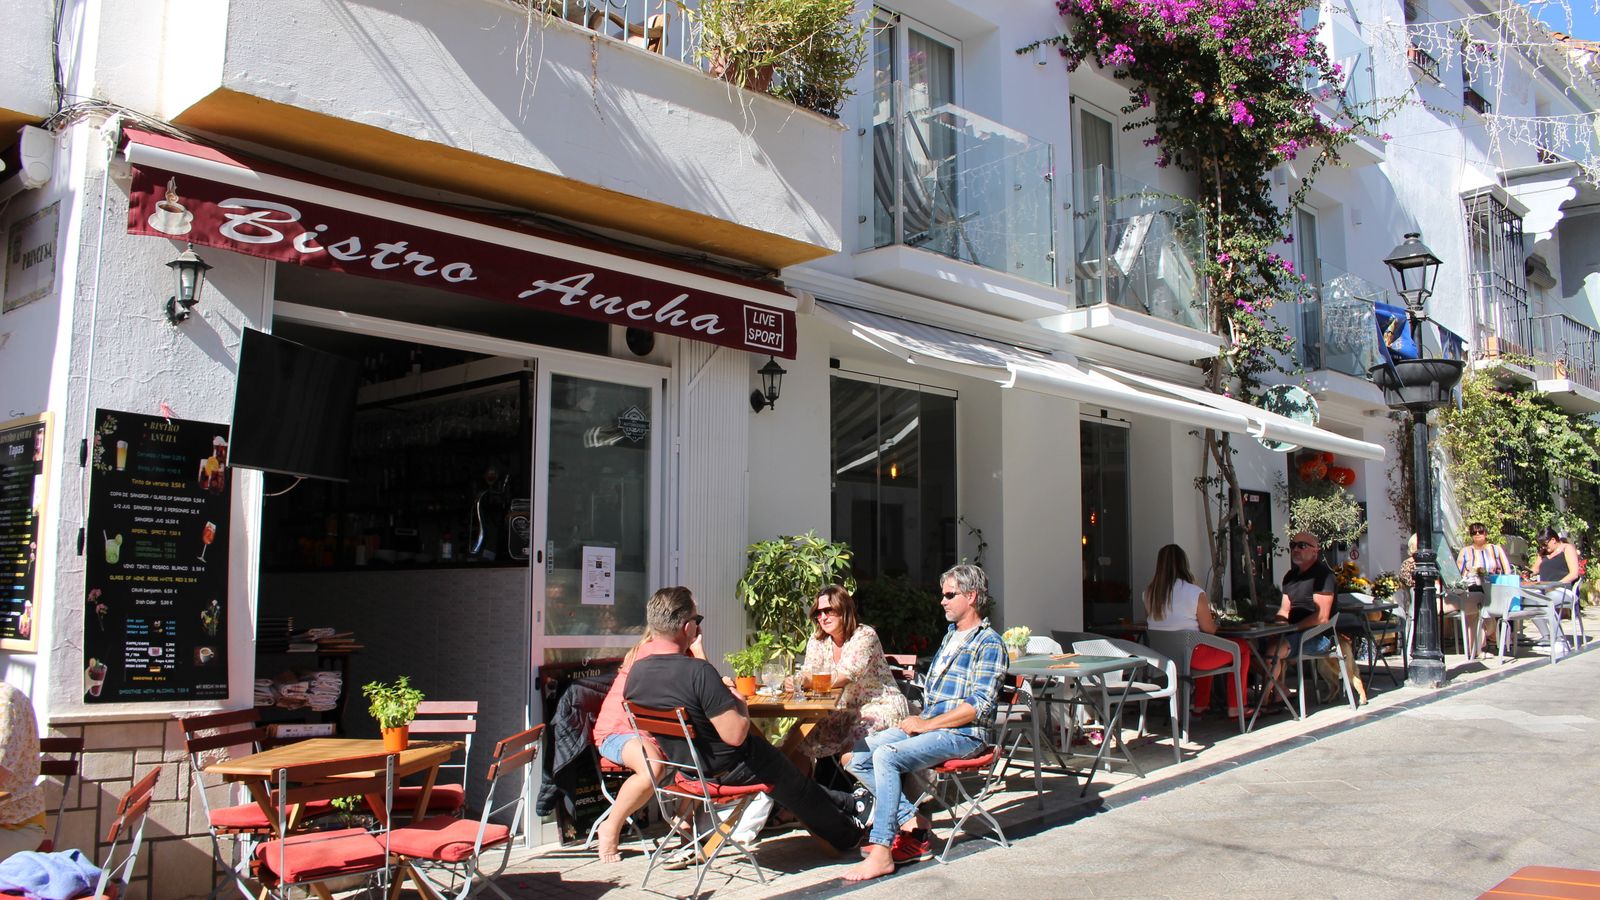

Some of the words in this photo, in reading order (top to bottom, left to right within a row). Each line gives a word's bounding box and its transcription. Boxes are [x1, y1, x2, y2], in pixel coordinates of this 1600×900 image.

[217, 197, 477, 282] Bistro
[518, 273, 725, 335] Ancha
[753, 312, 776, 327] LIVE
[748, 328, 782, 345] SPORT
[150, 421, 180, 432] BISTRO
[9, 445, 24, 459] Tapas
[572, 669, 601, 680] BISTRO
